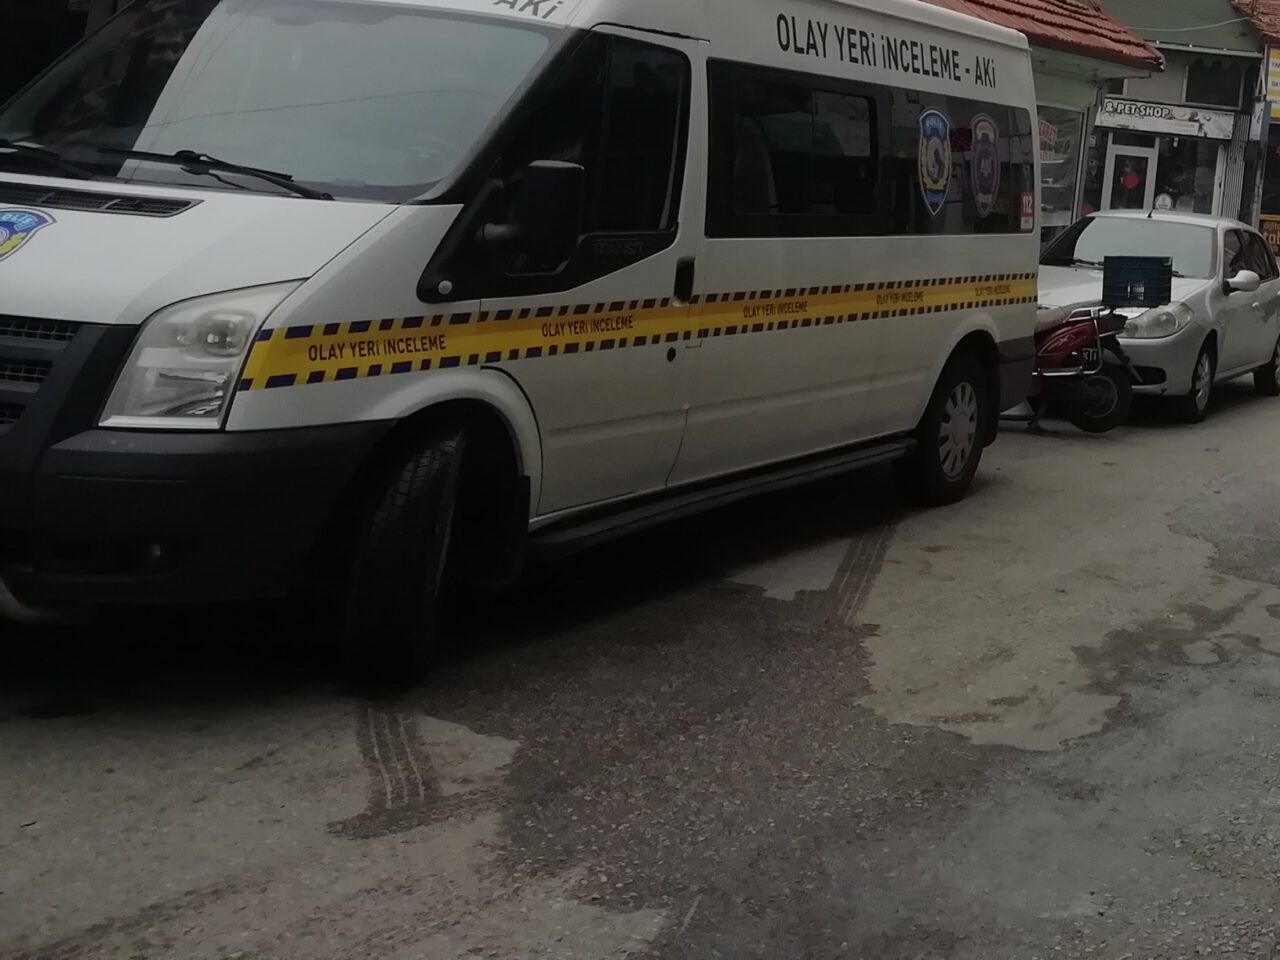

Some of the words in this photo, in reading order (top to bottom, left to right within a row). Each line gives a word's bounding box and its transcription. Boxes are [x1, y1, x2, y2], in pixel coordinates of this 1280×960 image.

[776, 13, 828, 58] OLAY
[1105, 102, 1114, 112] &
[1117, 103, 1137, 115] PET
[1139, 105, 1170, 118] SHOP
[541, 321, 566, 337] OLAY
[308, 343, 345, 361] OLAY
